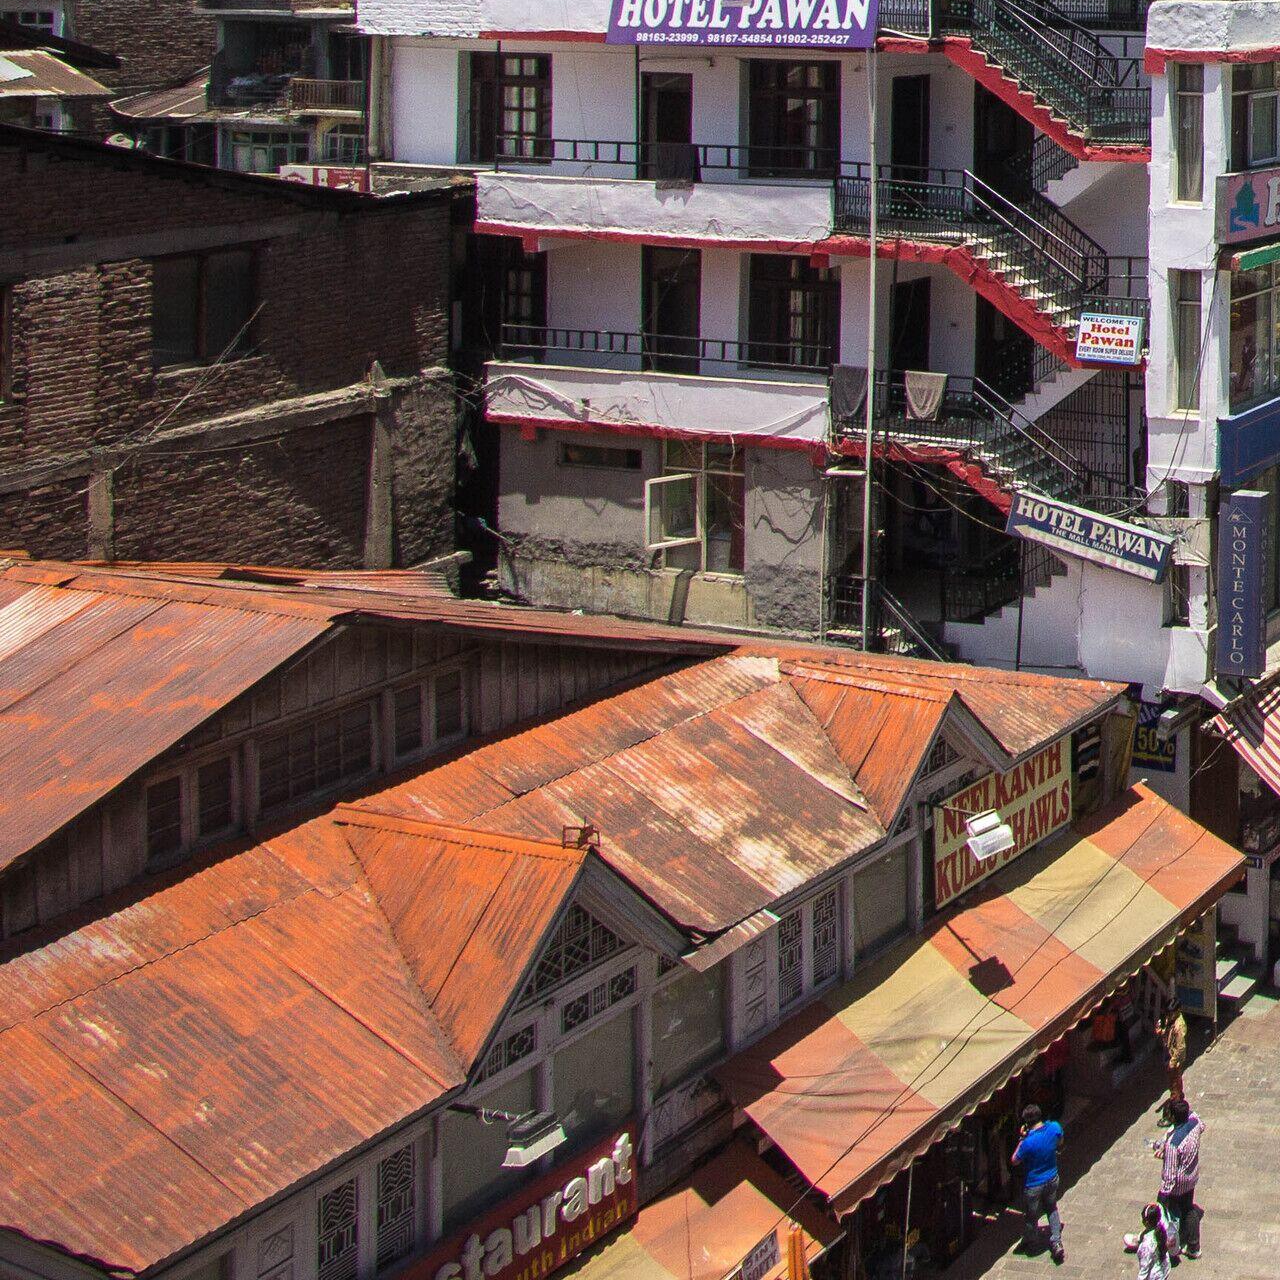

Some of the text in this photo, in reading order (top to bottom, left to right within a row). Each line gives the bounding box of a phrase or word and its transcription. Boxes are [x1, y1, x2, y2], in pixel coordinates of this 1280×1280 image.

[636, 32, 699, 43] 98163-23999
[707, 33, 772, 43] 98167-54854
[775, 34, 850, 45] 01902-252427
[1082, 316, 1125, 325] WELCOME
[1090, 323, 1130, 335] Hotel
[1080, 332, 1135, 348] Pawan
[1016, 496, 1165, 562] HOTEL PAWAN
[1051, 527, 1124, 557] THE MALL MANALI
[1230, 526, 1246, 664] MONTE CARLO
[560, 1198, 628, 1260] Indian
